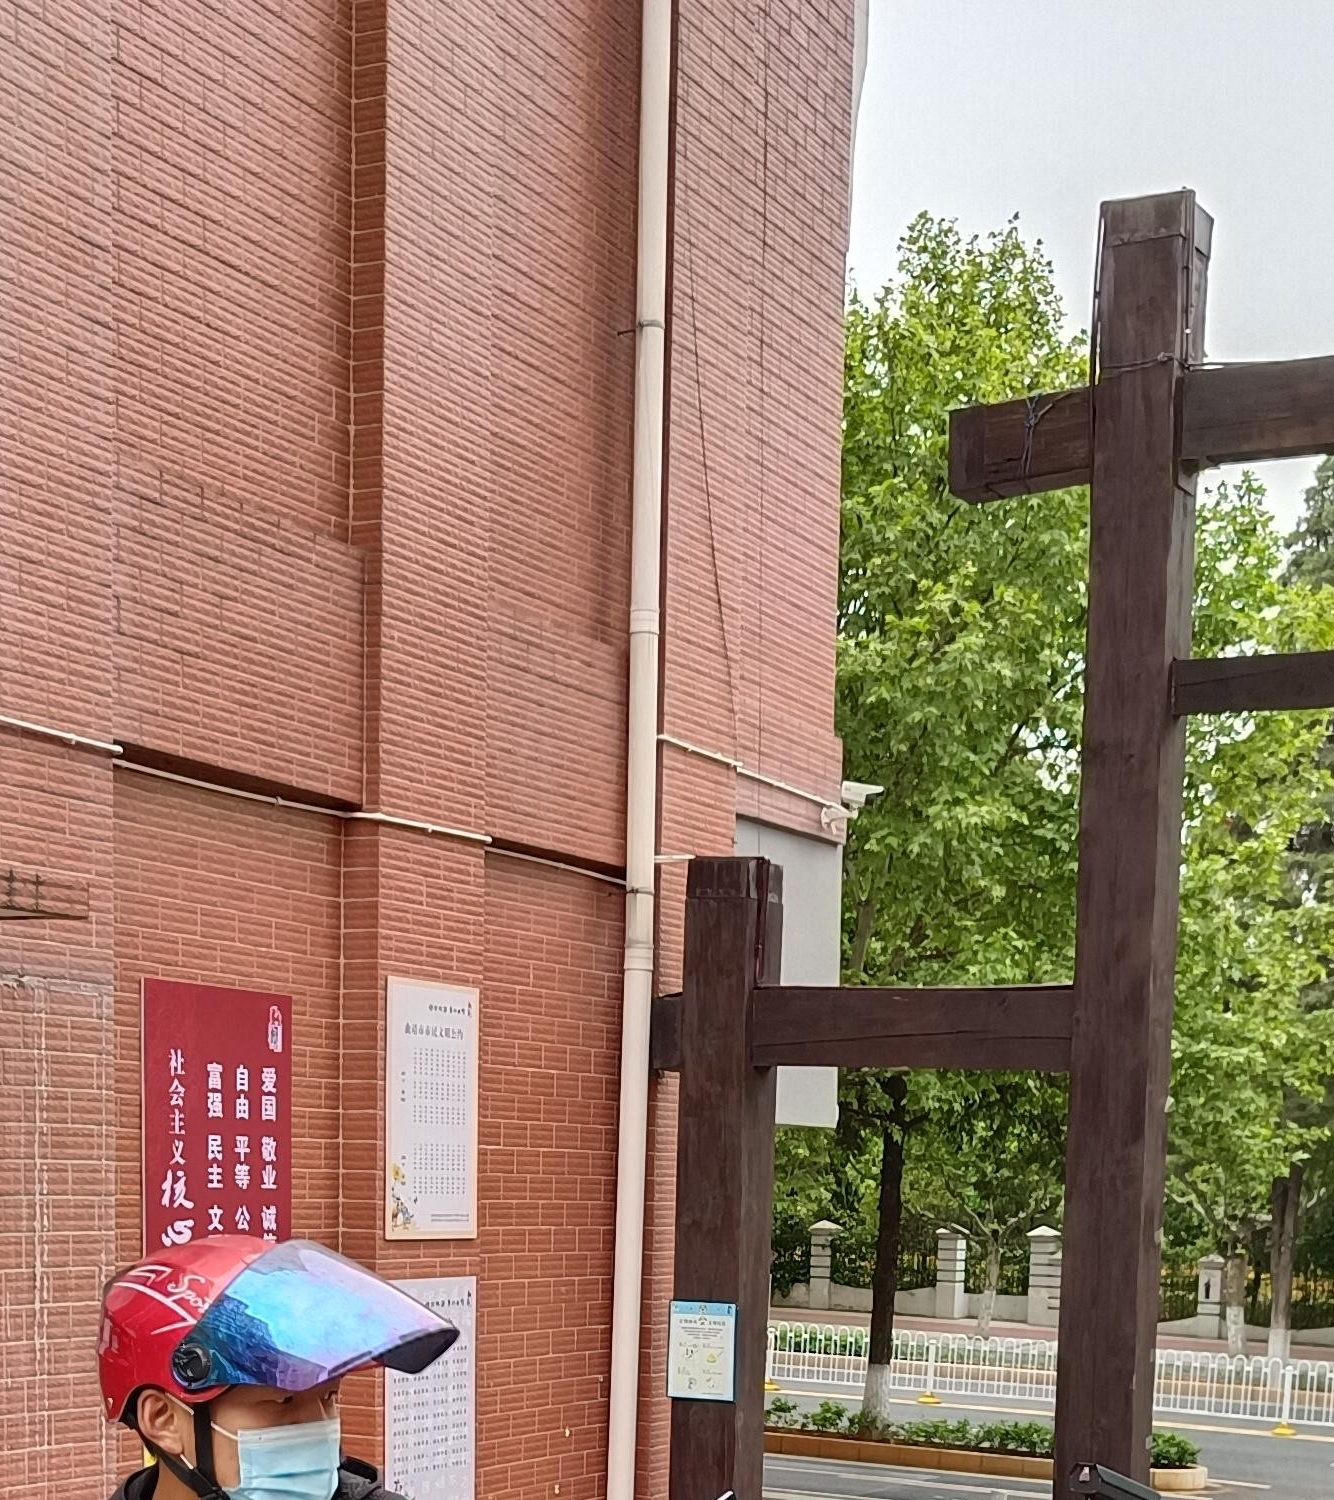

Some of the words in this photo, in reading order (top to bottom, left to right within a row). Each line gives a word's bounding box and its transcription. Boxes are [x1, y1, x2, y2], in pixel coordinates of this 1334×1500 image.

[206, 1062, 224, 1118] 富强
[235, 1064, 250, 1121] 自由
[261, 1067, 277, 1121] 爱国
[161, 1049, 194, 1247] 社会主义核心
[207, 1134, 224, 1189] 民主
[234, 1135, 250, 1190] 平等
[261, 1136, 277, 1190] 敬业
